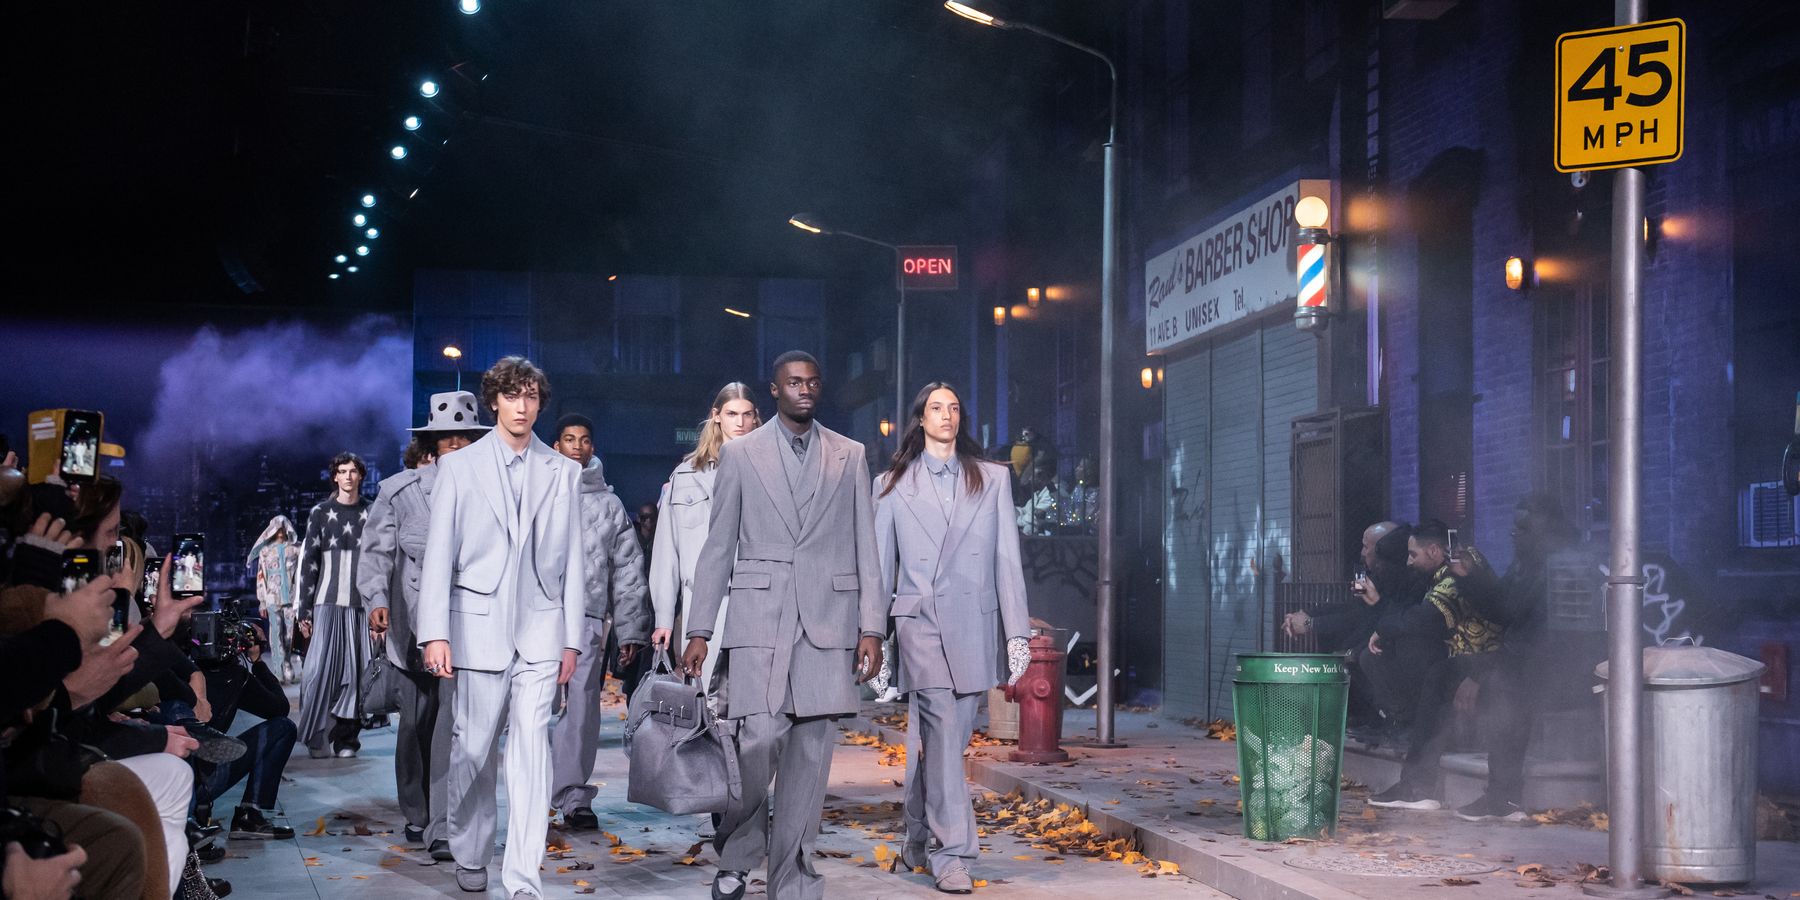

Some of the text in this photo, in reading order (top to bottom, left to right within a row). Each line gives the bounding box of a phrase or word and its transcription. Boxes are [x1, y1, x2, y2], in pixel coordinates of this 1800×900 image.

[1567, 40, 1672, 111] 45
[1583, 118, 1658, 150] MPH
[1185, 222, 1243, 294] BARBER
[1246, 195, 1295, 264] SHOP
[904, 258, 951, 274] OPEN
[1150, 327, 1156, 346] 11
[1172, 316, 1178, 337] B
[1185, 296, 1220, 332] UNISEX
[676, 431, 698, 441] RIVIN
[1274, 663, 1298, 676] Keep
[1301, 663, 1320, 673] New
[1322, 663, 1338, 673] York
